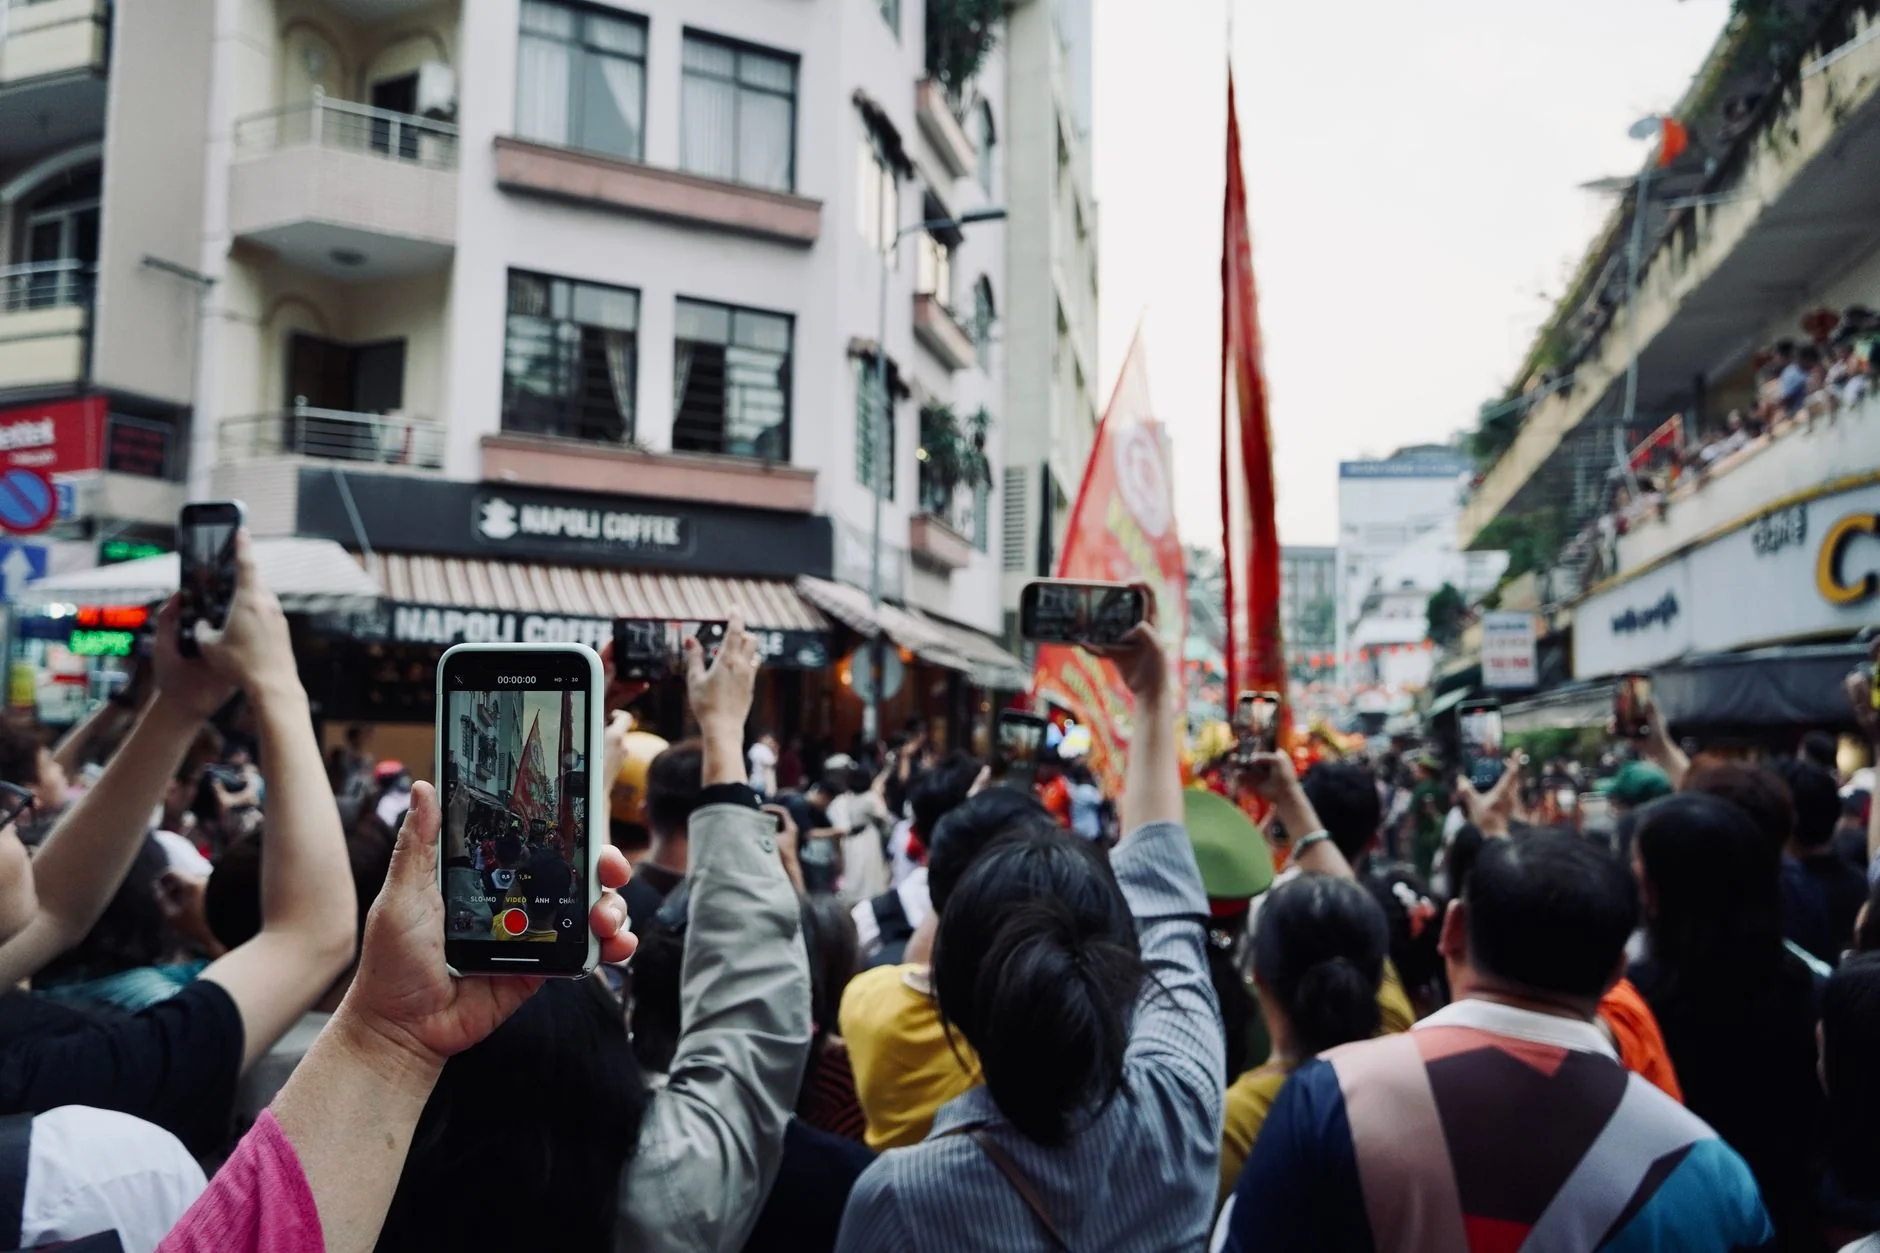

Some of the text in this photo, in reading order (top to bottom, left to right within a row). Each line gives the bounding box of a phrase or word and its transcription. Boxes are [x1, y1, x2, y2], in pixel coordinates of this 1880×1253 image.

[520, 505, 681, 546] NAPOLI COFFEE
[394, 606, 517, 645] NAPOLI
[497, 675, 537, 684] 00:00:00
